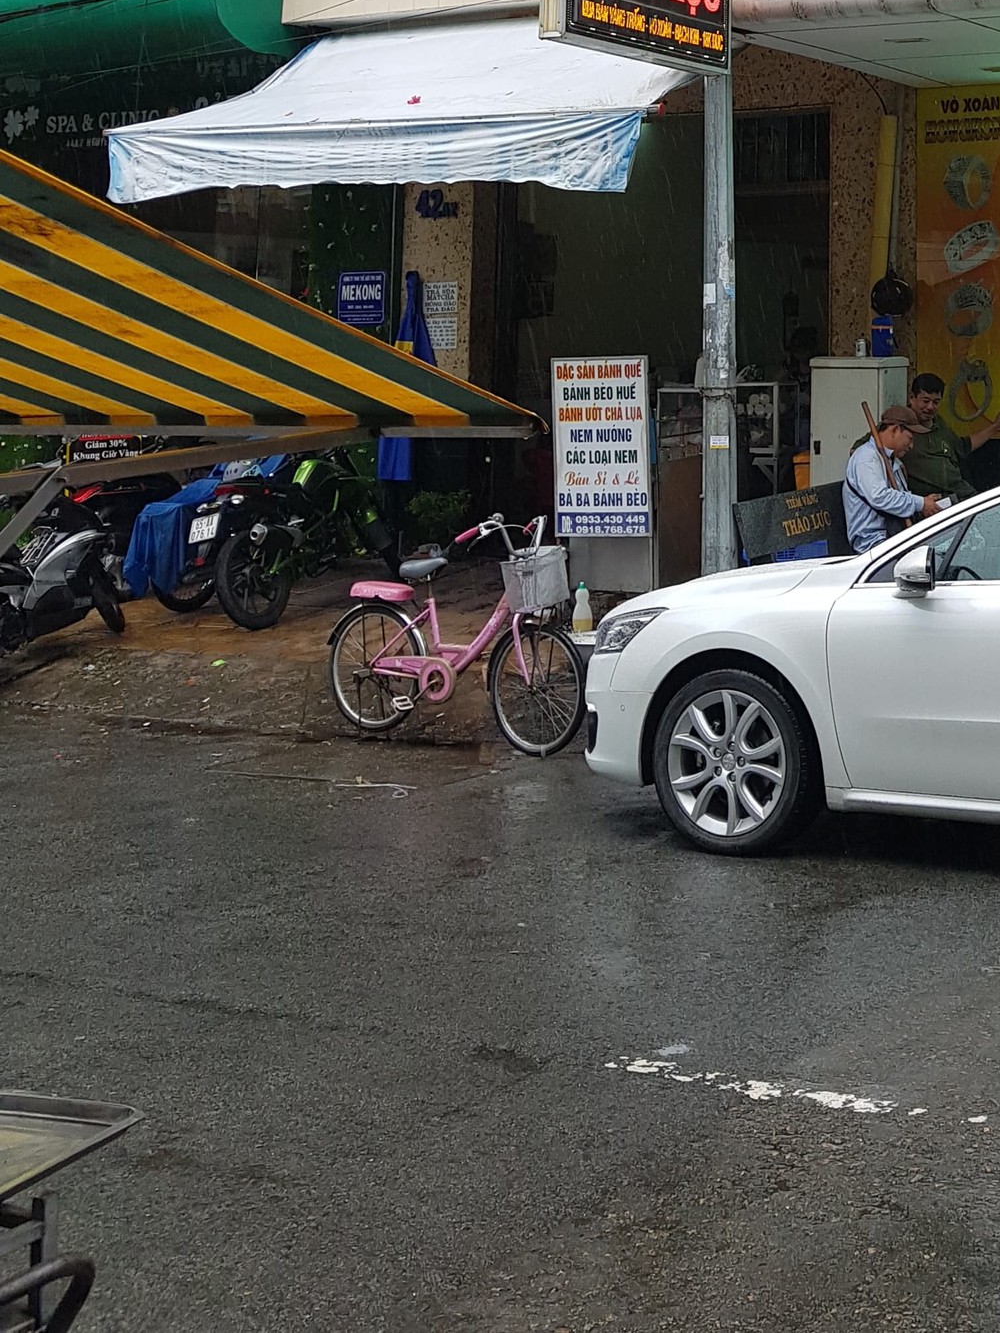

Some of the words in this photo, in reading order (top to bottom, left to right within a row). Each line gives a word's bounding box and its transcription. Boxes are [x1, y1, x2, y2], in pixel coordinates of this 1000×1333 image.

[341, 283, 382, 301] MEKONG
[563, 382, 591, 401] BÁNH
[594, 382, 613, 400] BÈO
[616, 382, 636, 400] HUẾ
[558, 403, 583, 422] BÁNH
[605, 401, 623, 421] CHẢ
[625, 406, 643, 423] LỤA
[570, 428, 593, 443] NEM
[596, 424, 632, 443] NƯỚNG
[85, 440, 107, 450] Giảm
[108, 439, 128, 448] 30%
[73, 452, 100, 461] Khung
[566, 446, 586, 465] CÁC
[589, 450, 612, 466] LOẠI
[614, 450, 638, 464] NEM
[558, 489, 573, 507] BÀ
[576, 493, 591, 507] BA
[593, 488, 623, 507] BÁNH
[626, 488, 648, 507] BÈO
[575, 516, 623, 524] 0933.430
[575, 525, 646, 534] 0918.768.678
